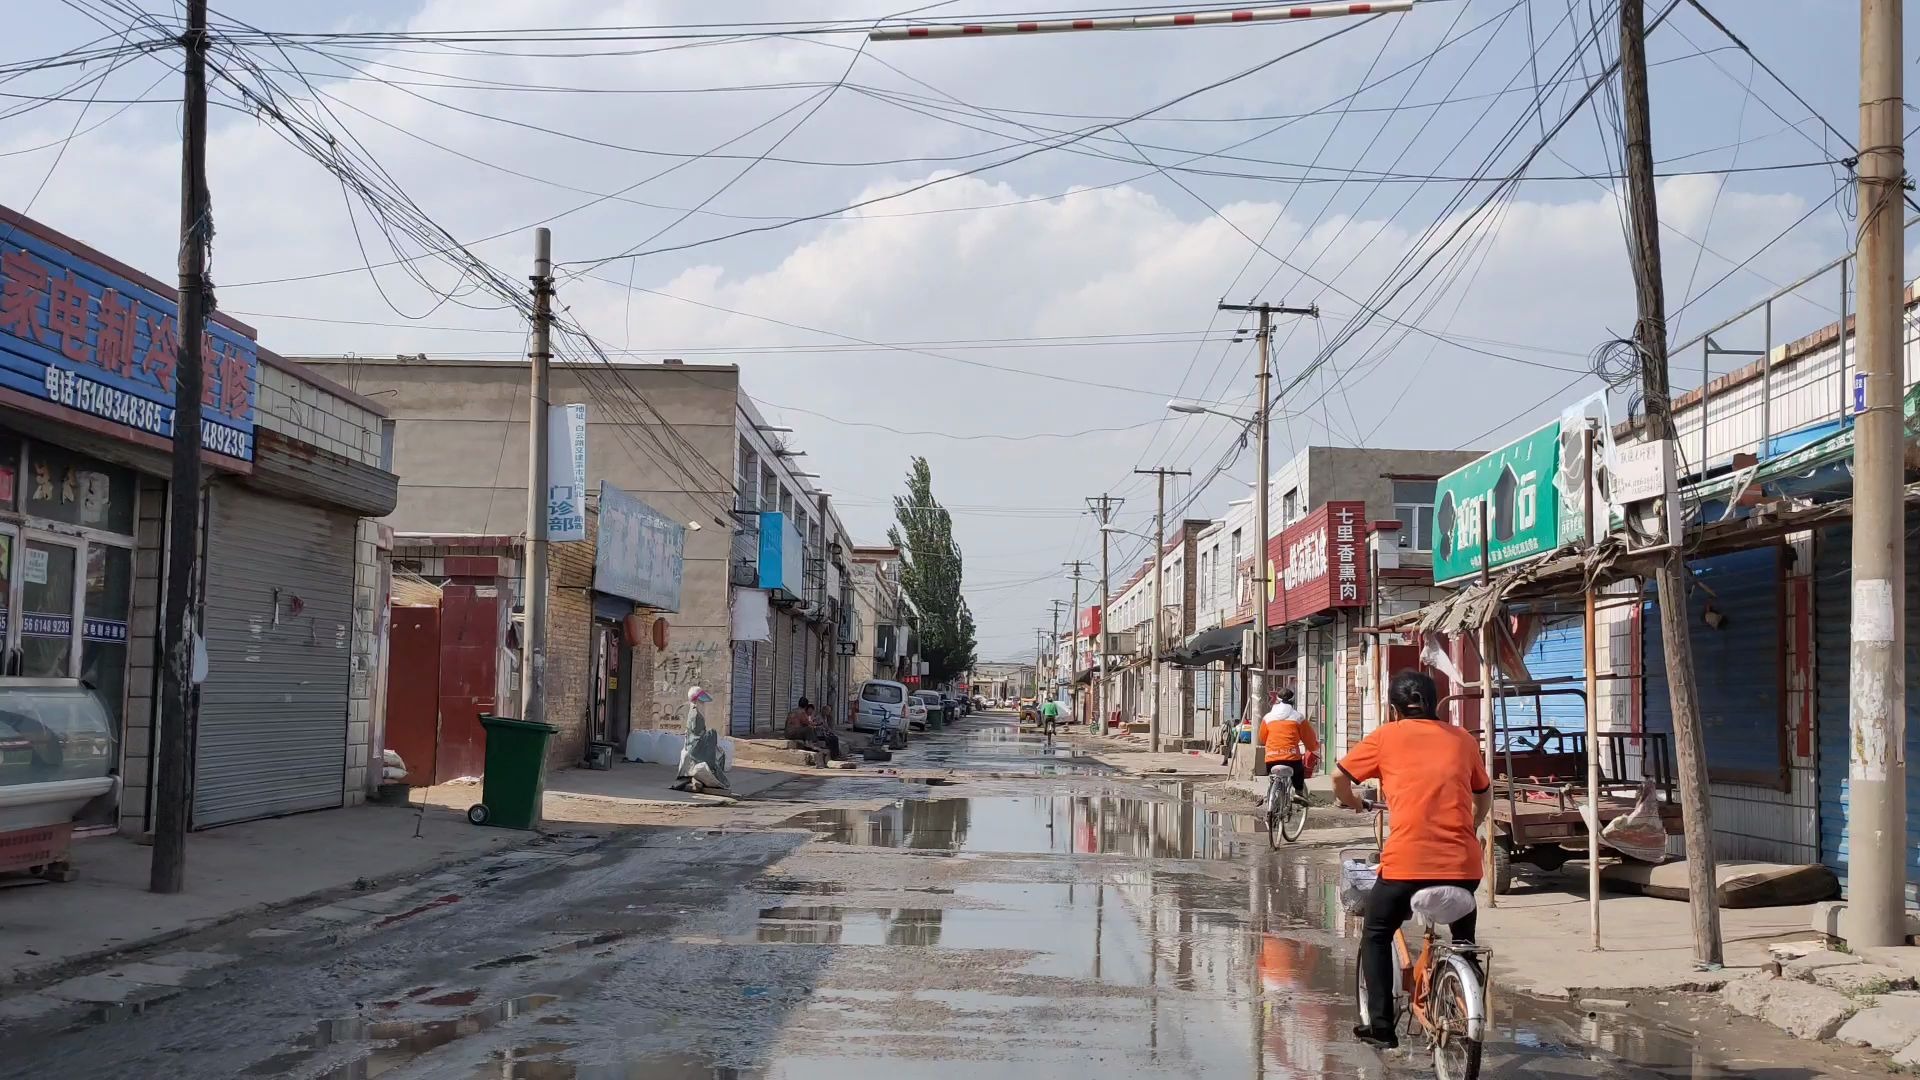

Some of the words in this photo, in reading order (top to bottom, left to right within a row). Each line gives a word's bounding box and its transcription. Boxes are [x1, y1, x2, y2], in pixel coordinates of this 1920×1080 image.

[548, 485, 575, 532] 门诊部
[1336, 508, 1357, 601] 七里香熏肉
